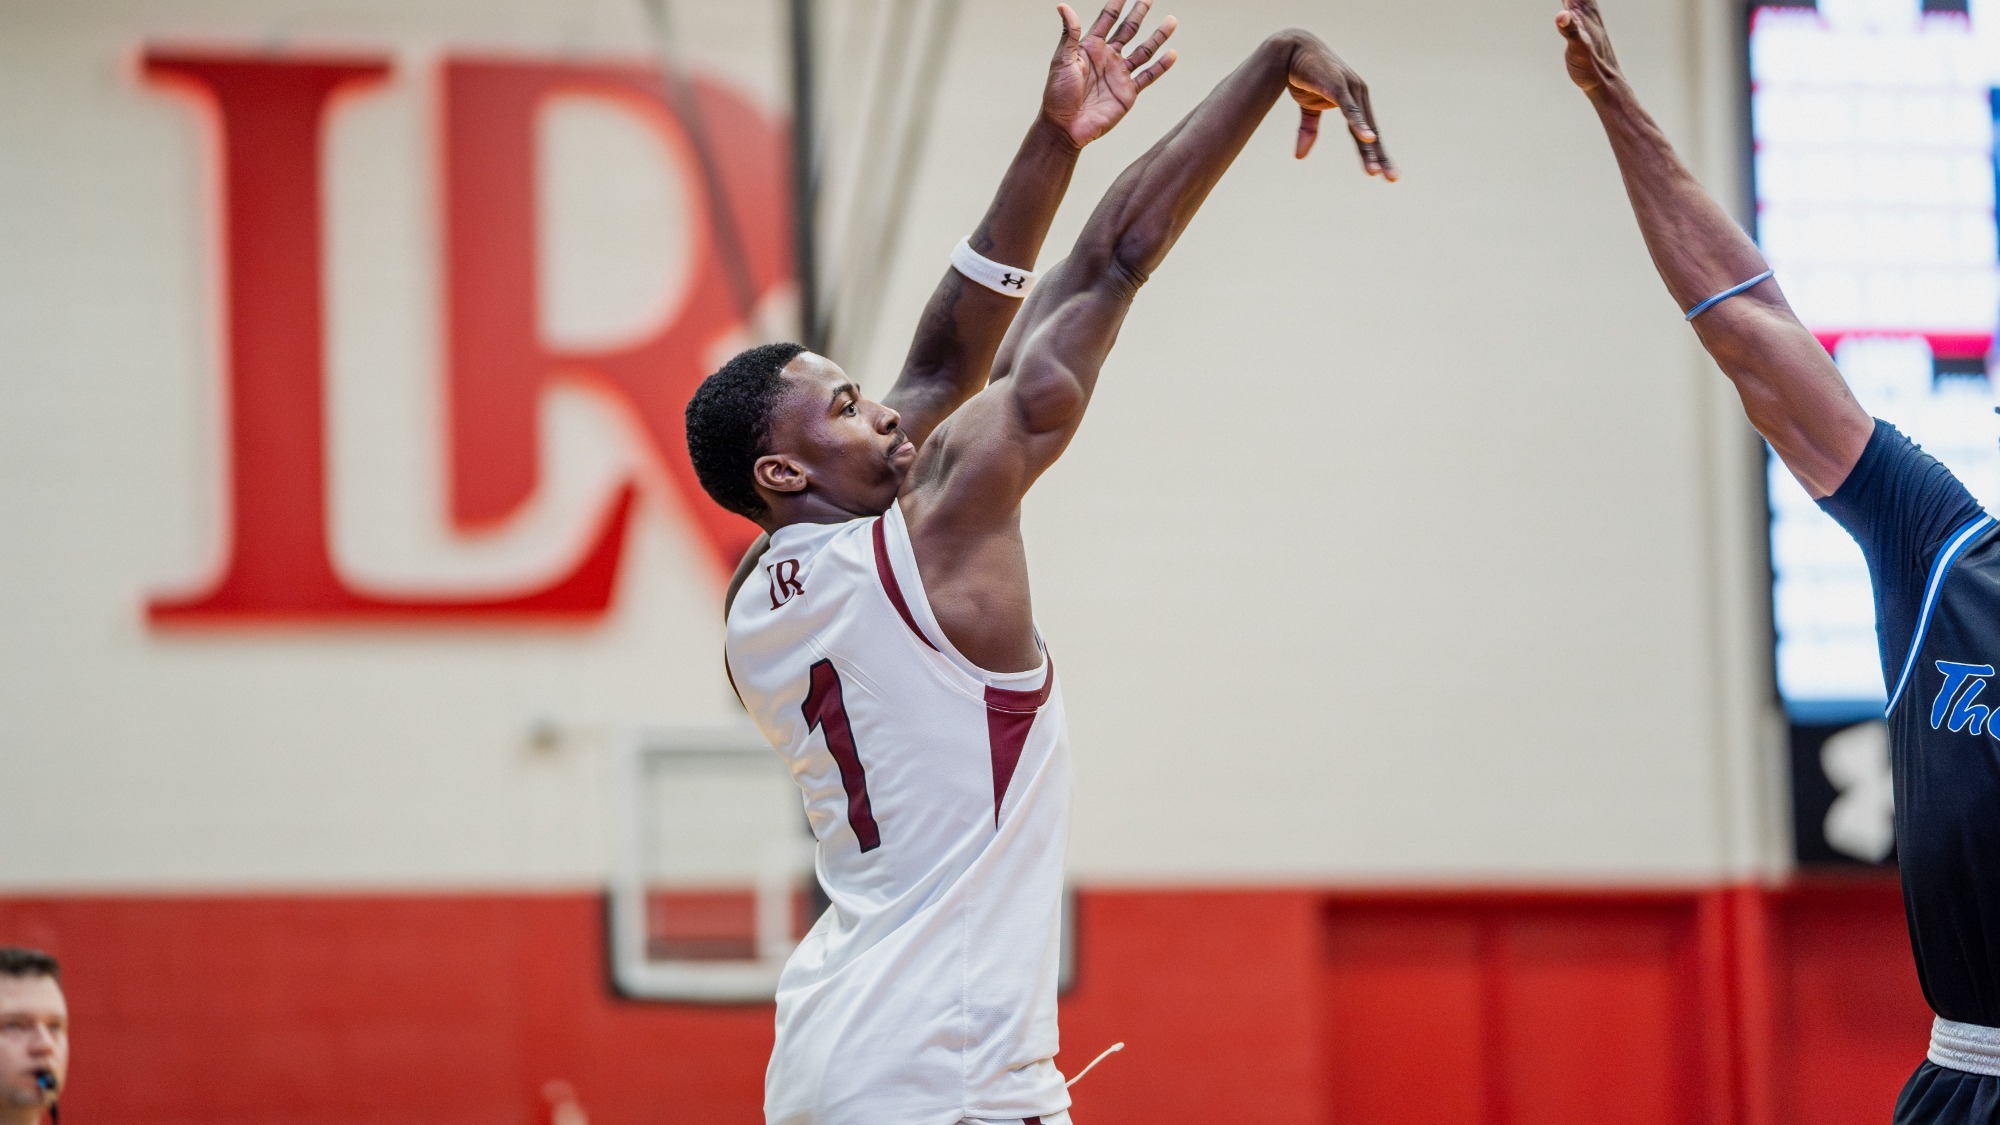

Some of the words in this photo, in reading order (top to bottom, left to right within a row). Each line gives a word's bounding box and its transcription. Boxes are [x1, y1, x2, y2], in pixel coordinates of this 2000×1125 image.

[142, 50, 800, 630] LR
[766, 558, 805, 612] LR
[801, 657, 882, 854] 1
